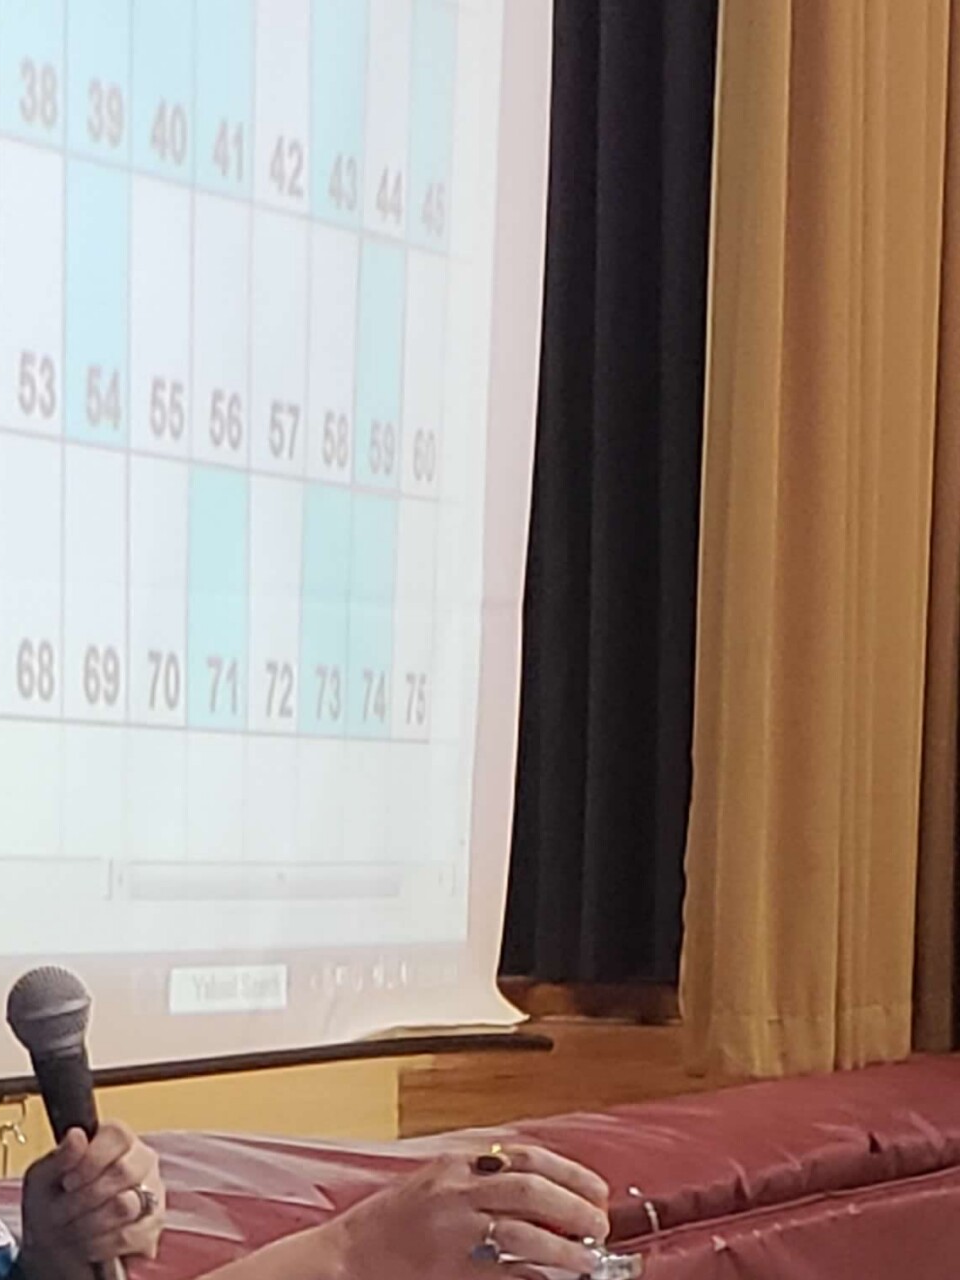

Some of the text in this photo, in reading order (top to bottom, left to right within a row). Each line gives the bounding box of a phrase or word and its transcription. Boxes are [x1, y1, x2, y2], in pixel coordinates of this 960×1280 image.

[19, 56, 58, 128] 38
[87, 79, 124, 148] 39
[150, 99, 188, 166] 40
[213, 118, 245, 181] 41
[269, 135, 304, 199] 42
[328, 154, 358, 212] 43
[375, 164, 404, 225] 44
[18, 349, 56, 420] 53
[86, 363, 121, 431] 54
[149, 377, 185, 441] 55
[209, 390, 242, 451] 56
[268, 399, 300, 459] 57
[322, 411, 349, 469] 58
[369, 418, 395, 475] 59
[413, 427, 436, 483] 60
[17, 638, 54, 702] 68
[83, 645, 119, 705] 69
[147, 650, 180, 712] 70
[207, 655, 239, 716] 71
[265, 660, 293, 718] 72
[315, 663, 340, 721] 73
[362, 667, 385, 723] 74
[405, 672, 426, 725] 75
